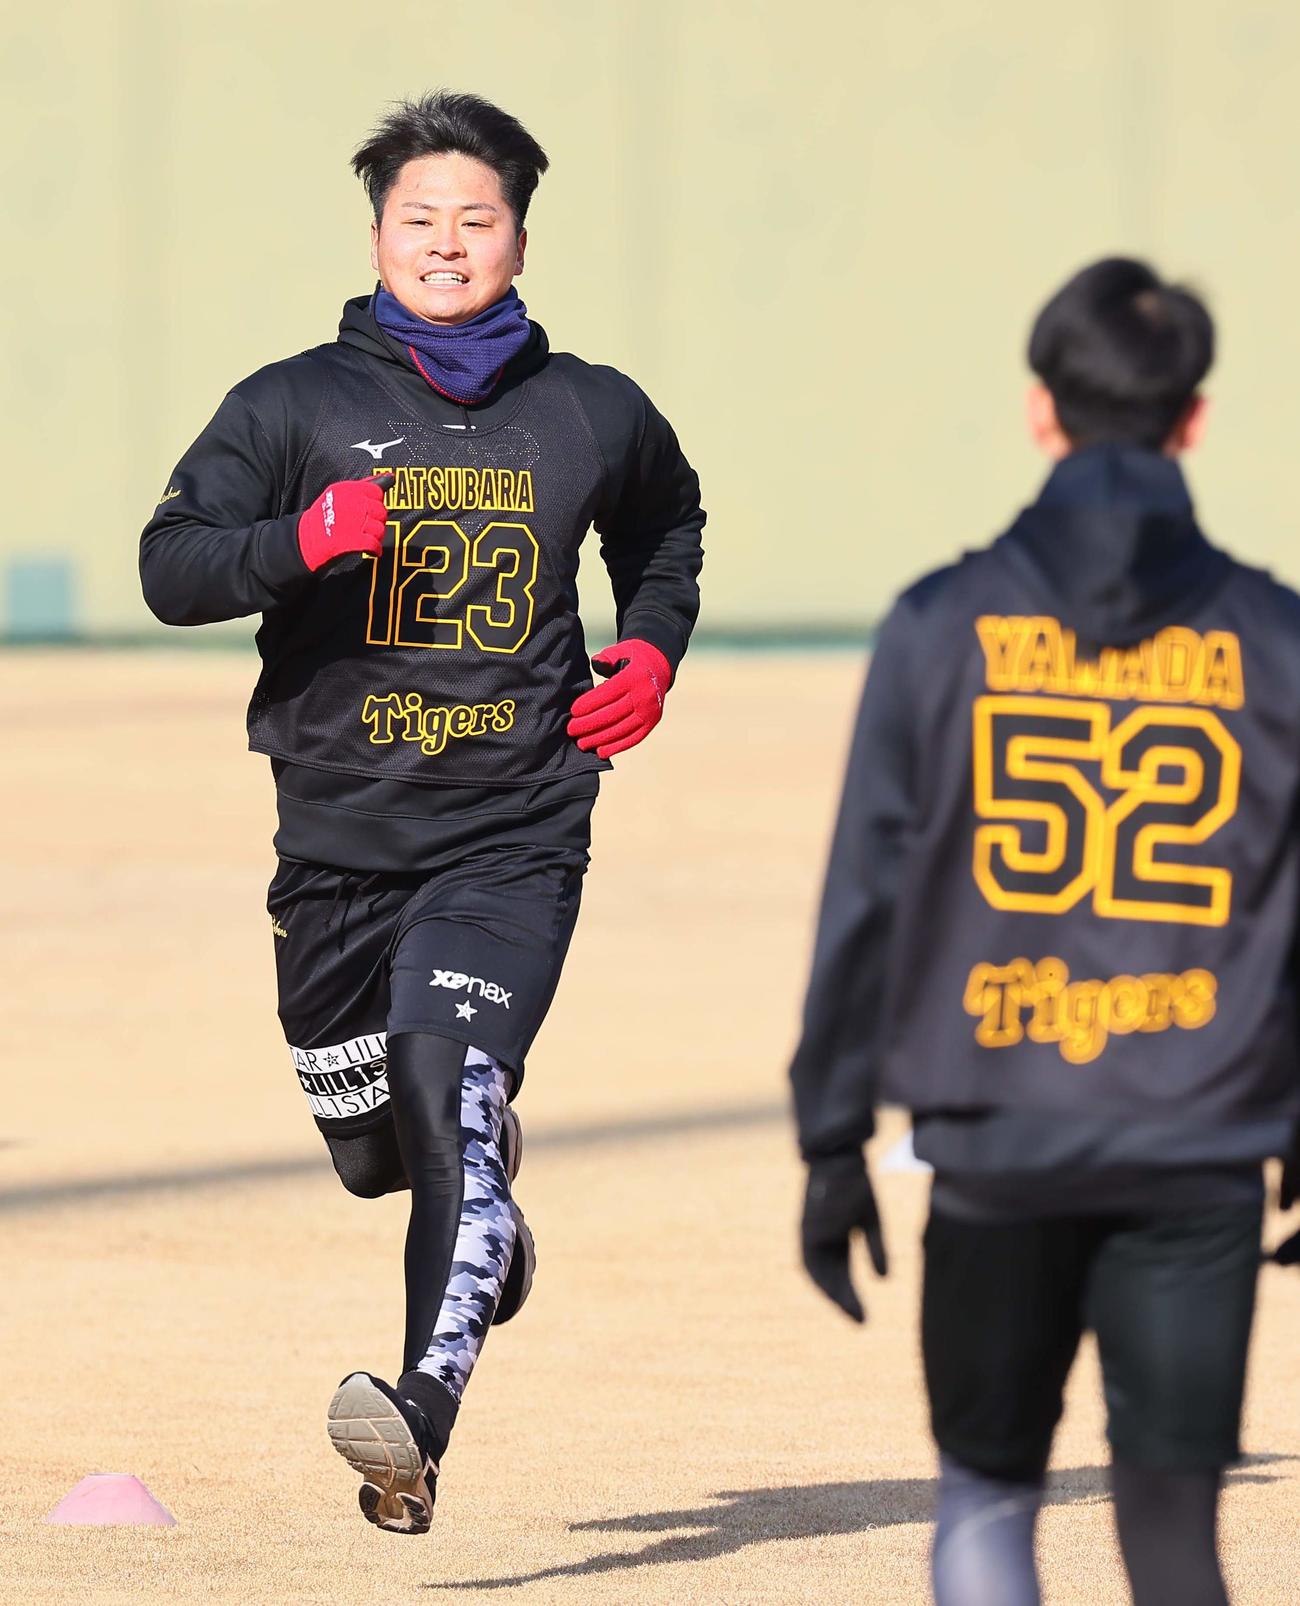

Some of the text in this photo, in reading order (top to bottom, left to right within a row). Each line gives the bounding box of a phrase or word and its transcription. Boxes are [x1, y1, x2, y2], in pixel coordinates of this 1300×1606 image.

[362, 520, 540, 654] 123
[362, 692, 516, 756] Tigers
[972, 694, 1243, 928] 52
[962, 955, 1218, 1065] Tigers
